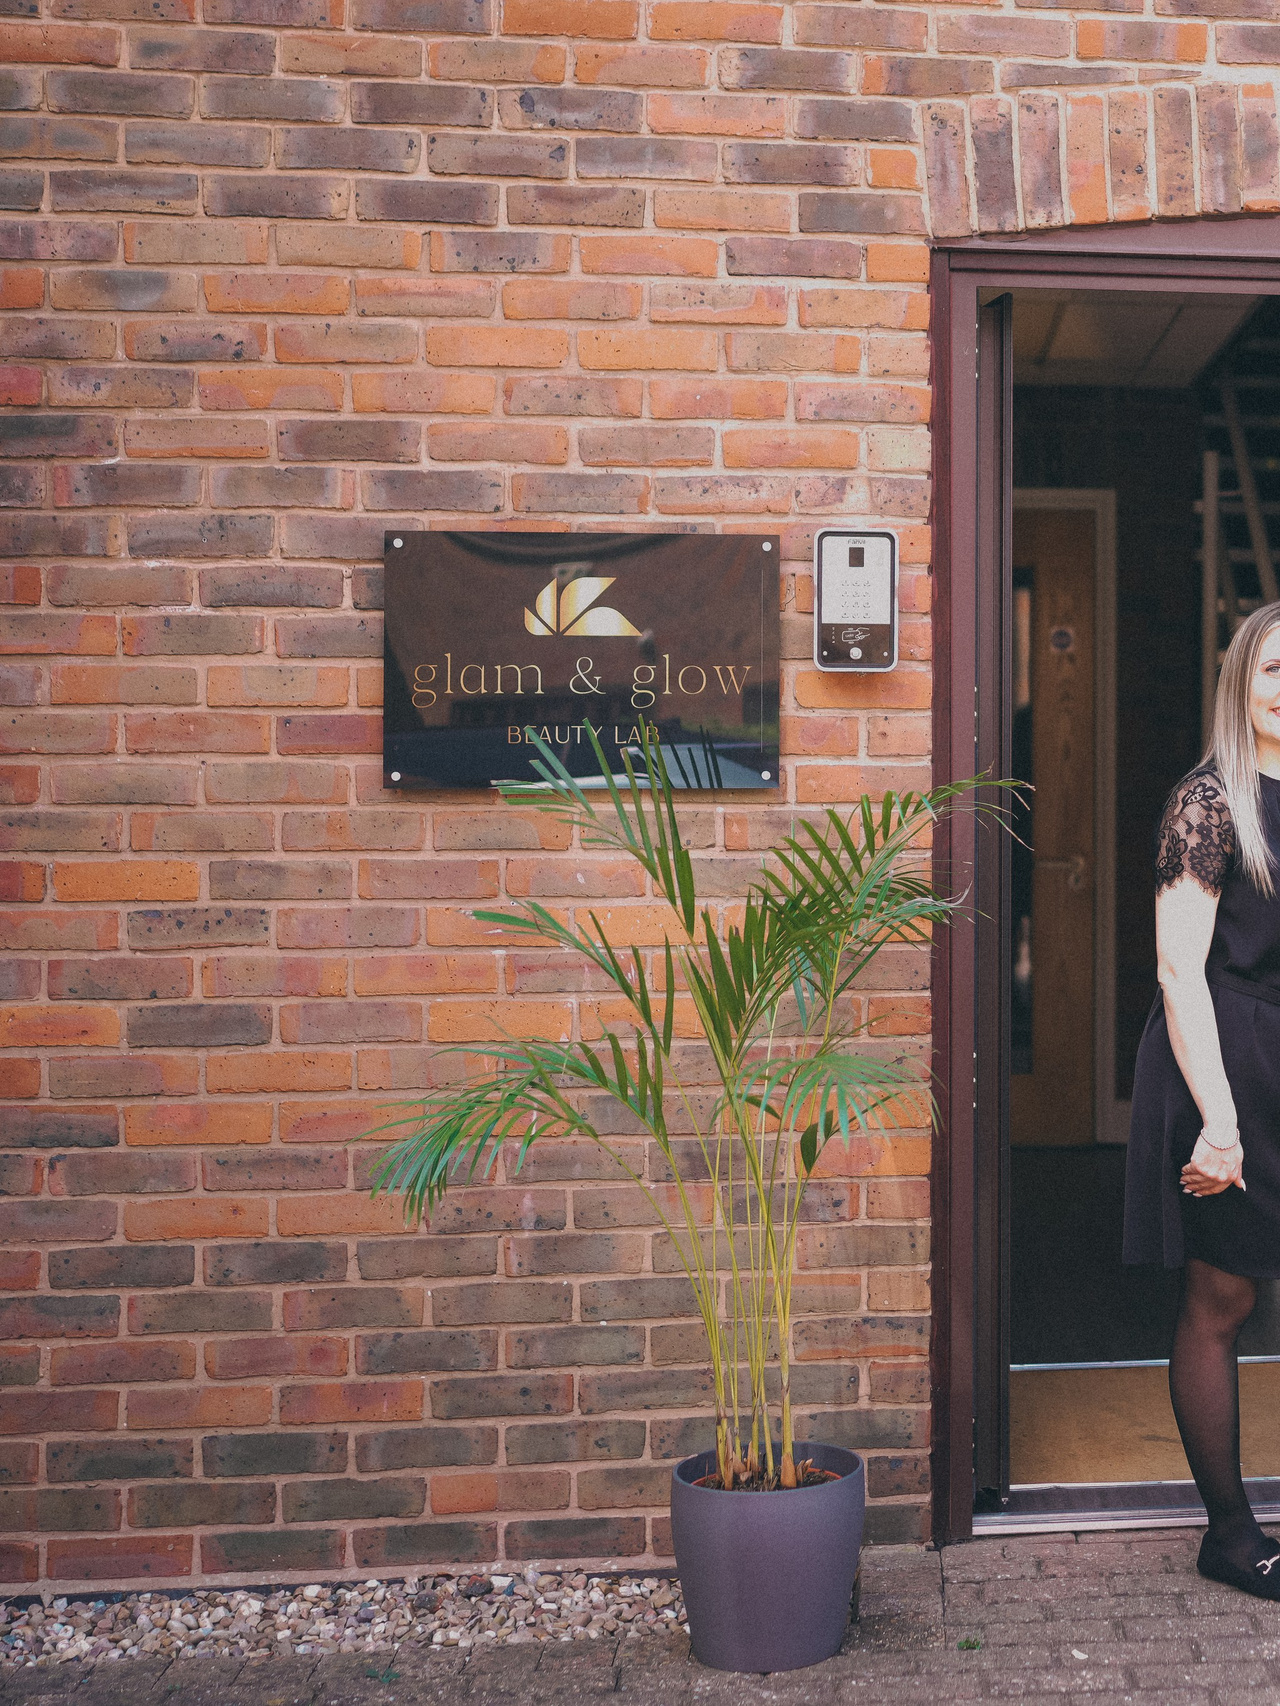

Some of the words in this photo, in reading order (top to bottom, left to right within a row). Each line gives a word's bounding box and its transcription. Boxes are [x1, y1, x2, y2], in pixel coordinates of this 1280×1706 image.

[411, 652, 544, 710] glam
[568, 655, 606, 697] &
[630, 653, 753, 710] glow
[506, 724, 604, 746] BEAUTY
[613, 725, 661, 746] LAB
